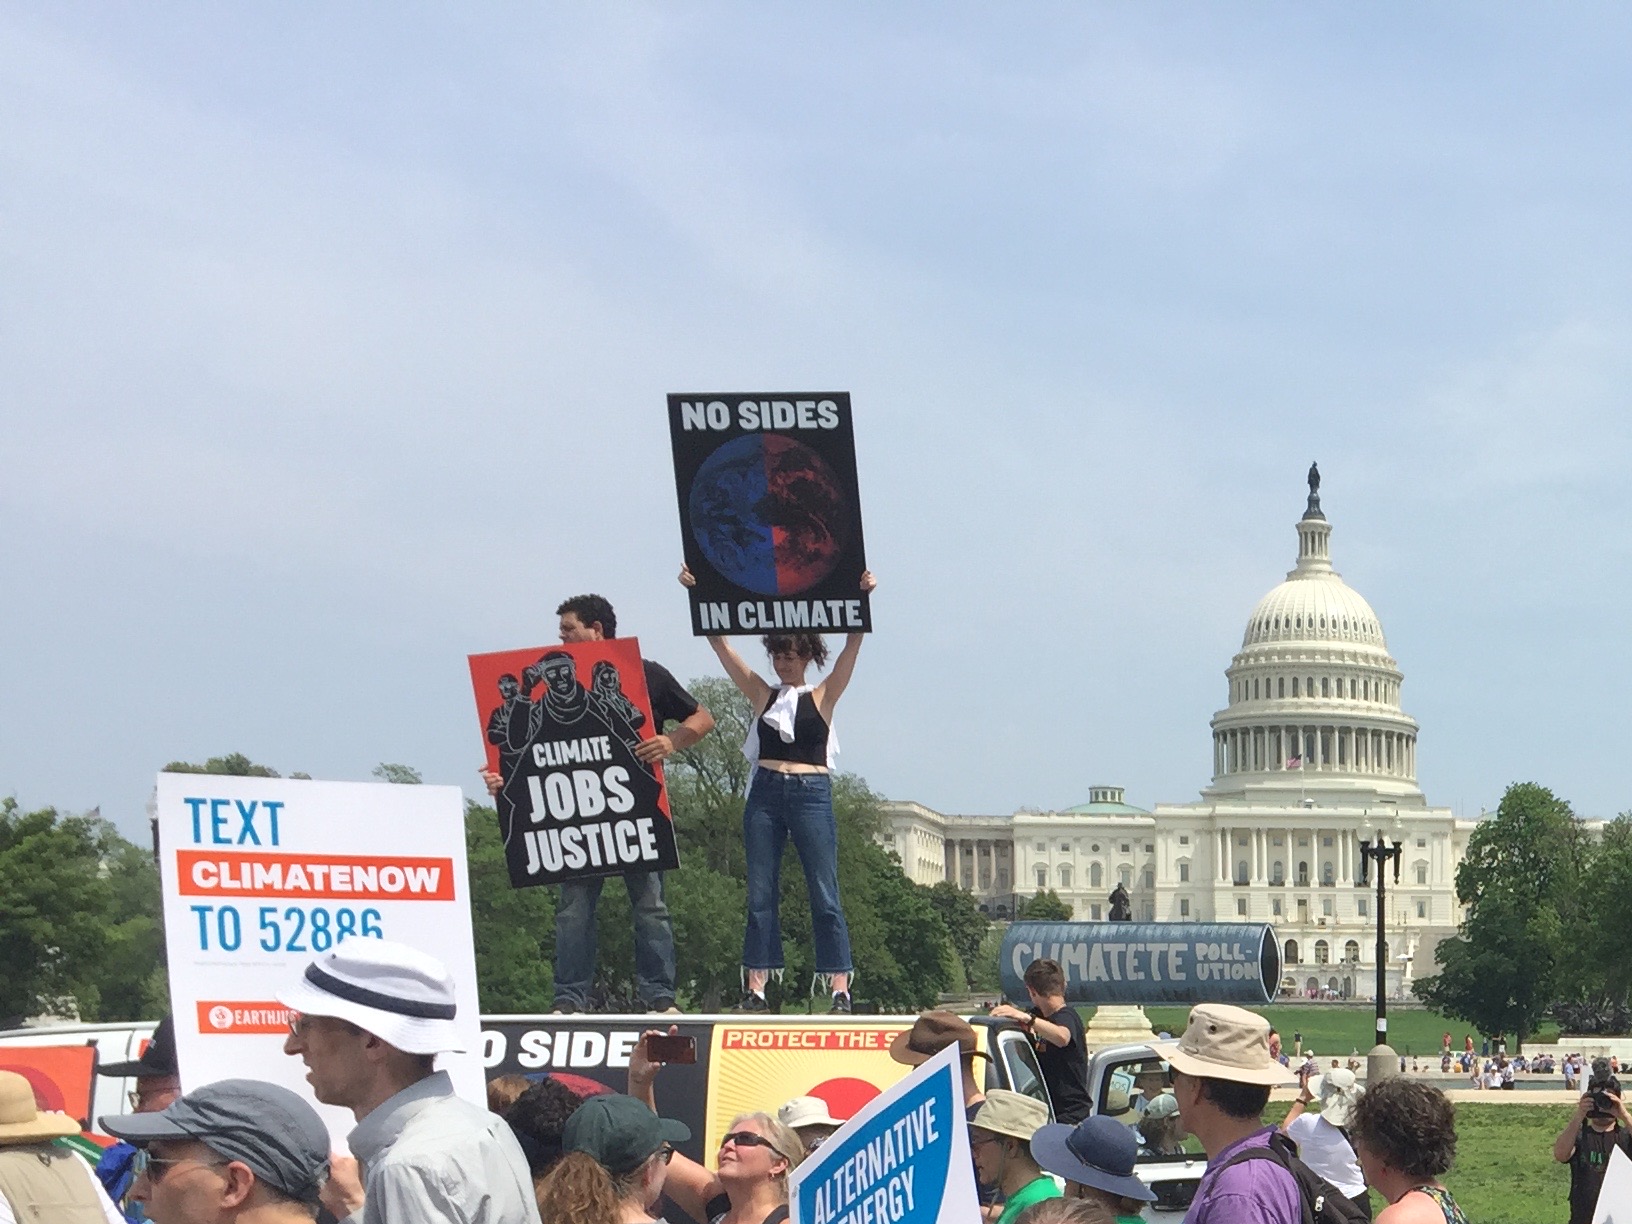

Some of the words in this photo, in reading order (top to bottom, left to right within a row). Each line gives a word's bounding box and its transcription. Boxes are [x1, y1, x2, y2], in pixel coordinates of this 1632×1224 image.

[681, 400, 731, 431] NO
[737, 400, 840, 431] SIDES
[699, 602, 731, 630] IN
[737, 599, 863, 630] CLIMATE
[532, 735, 612, 768] CLIMATE
[527, 765, 635, 824] JOBS
[183, 797, 285, 846] TEXT
[523, 817, 659, 875] JUSTICE
[191, 860, 441, 894] CLIMATENOW
[190, 905, 242, 951] TO
[259, 906, 384, 952] 52886
[1196, 962, 1260, 981] UTION
[481, 1032, 507, 1068] O
[517, 1031, 640, 1068] SIDE
[727, 1031, 829, 1048] PROTECT
[834, 1031, 879, 1048] THE
